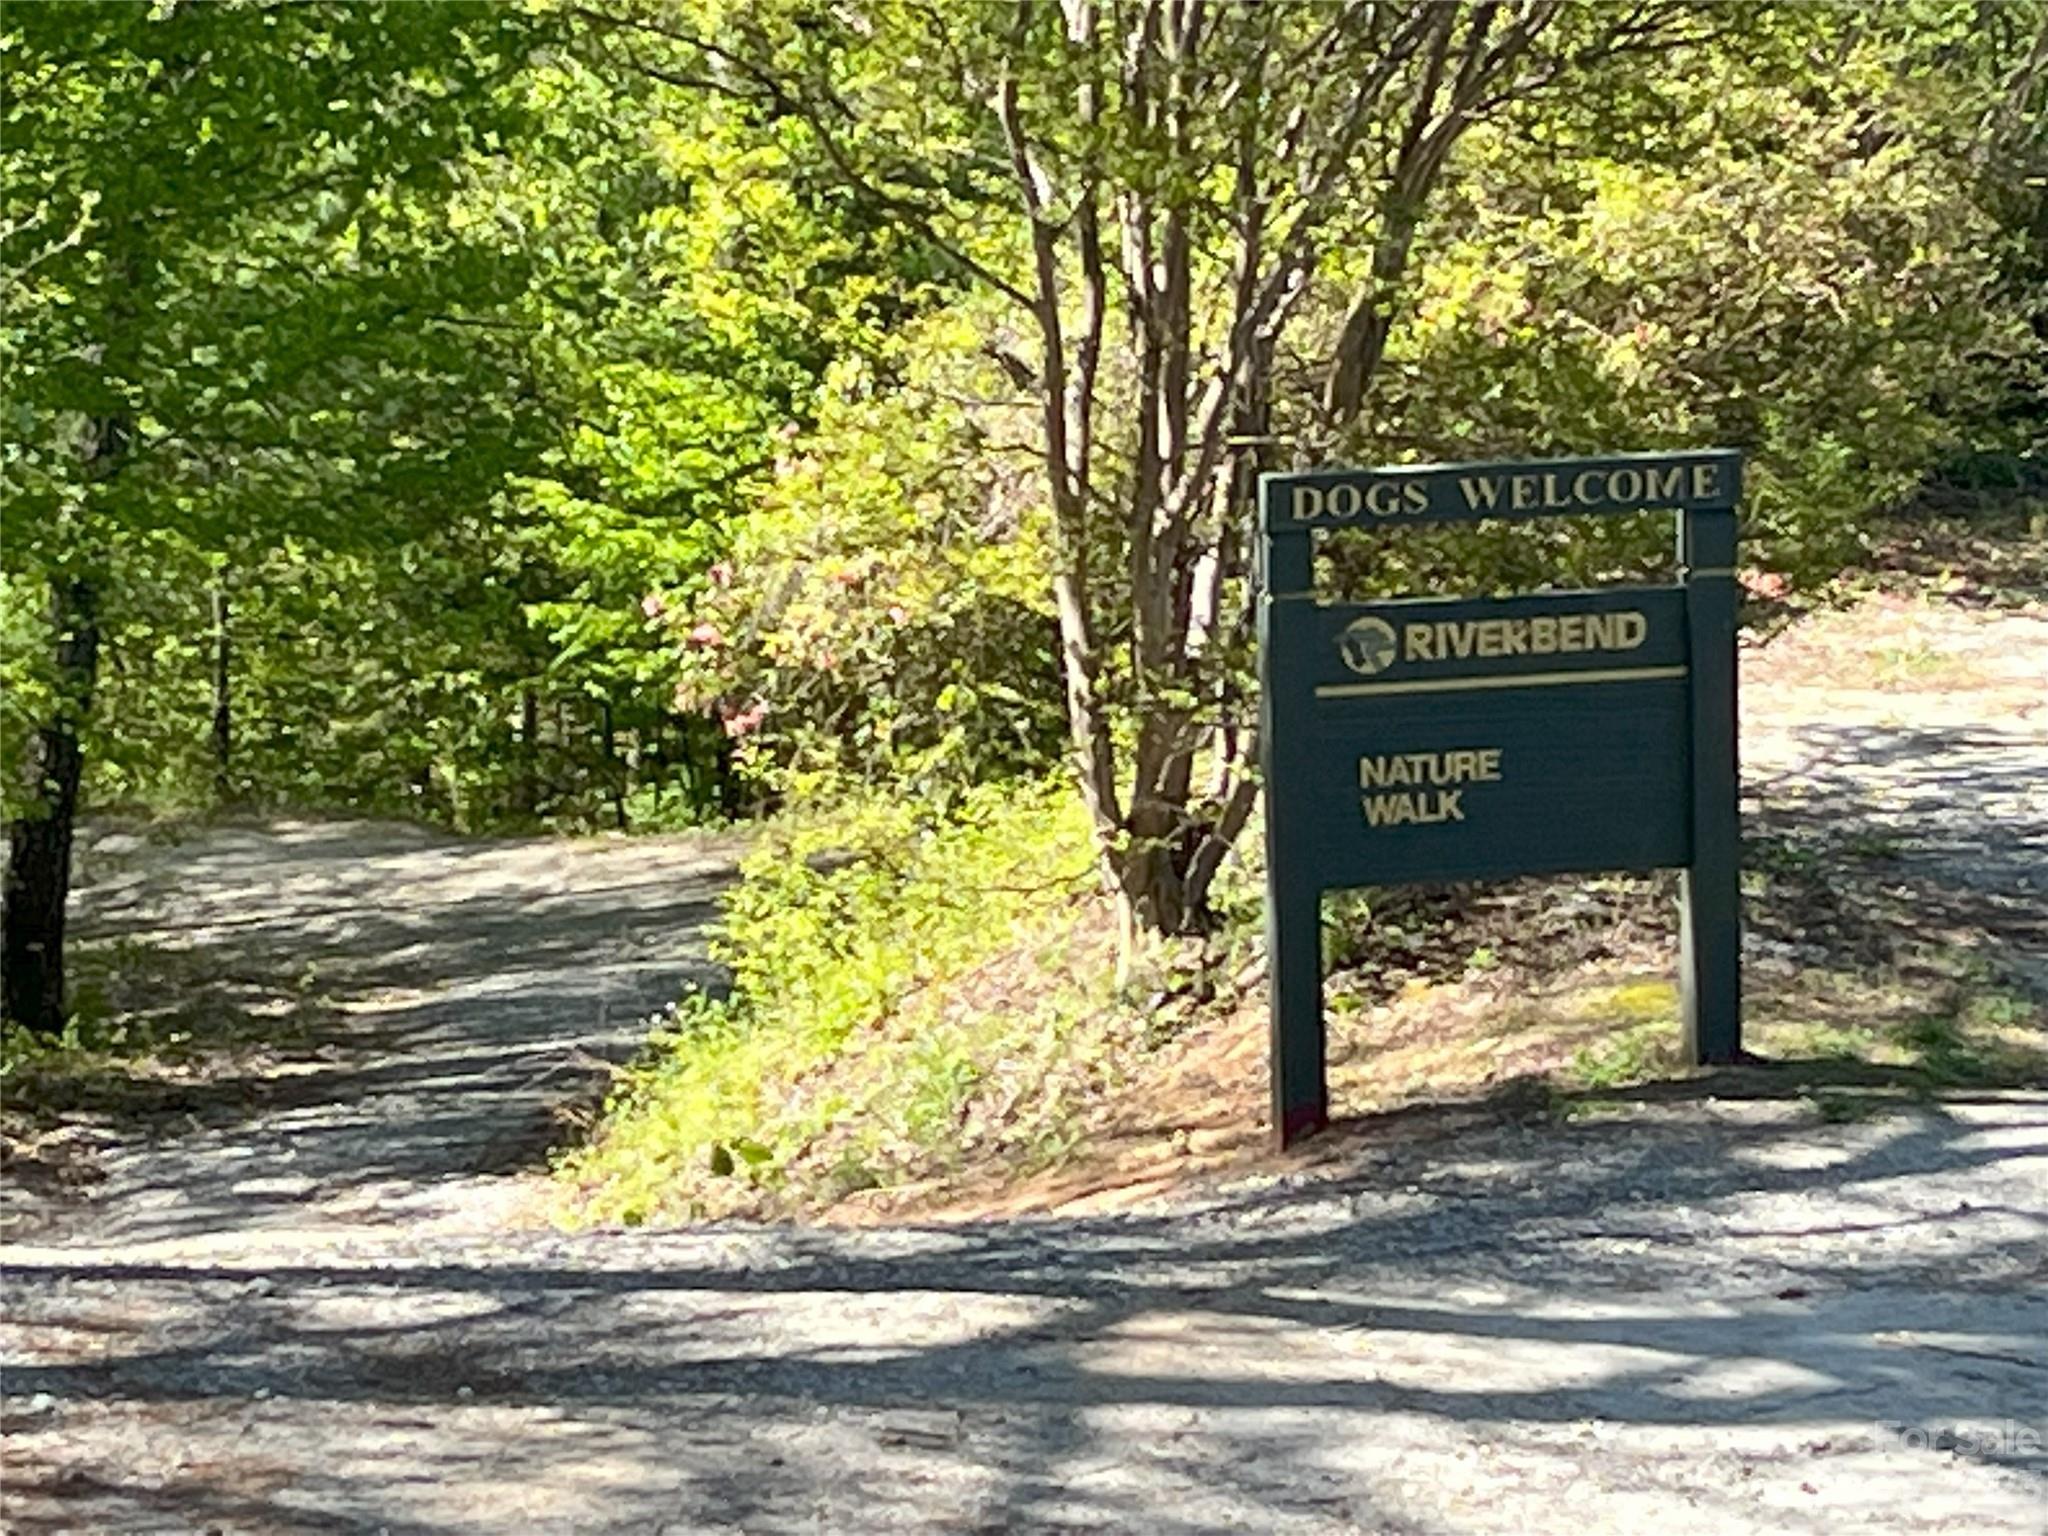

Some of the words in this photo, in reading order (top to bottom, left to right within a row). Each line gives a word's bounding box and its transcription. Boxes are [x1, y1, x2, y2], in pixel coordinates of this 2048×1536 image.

[1292, 480, 1429, 520] DOGS
[1459, 465, 1721, 511] WELCOME
[1405, 612, 1647, 661] RIVERBEND
[1359, 748, 1503, 788] NATURE
[1363, 791, 1465, 827] WALK
